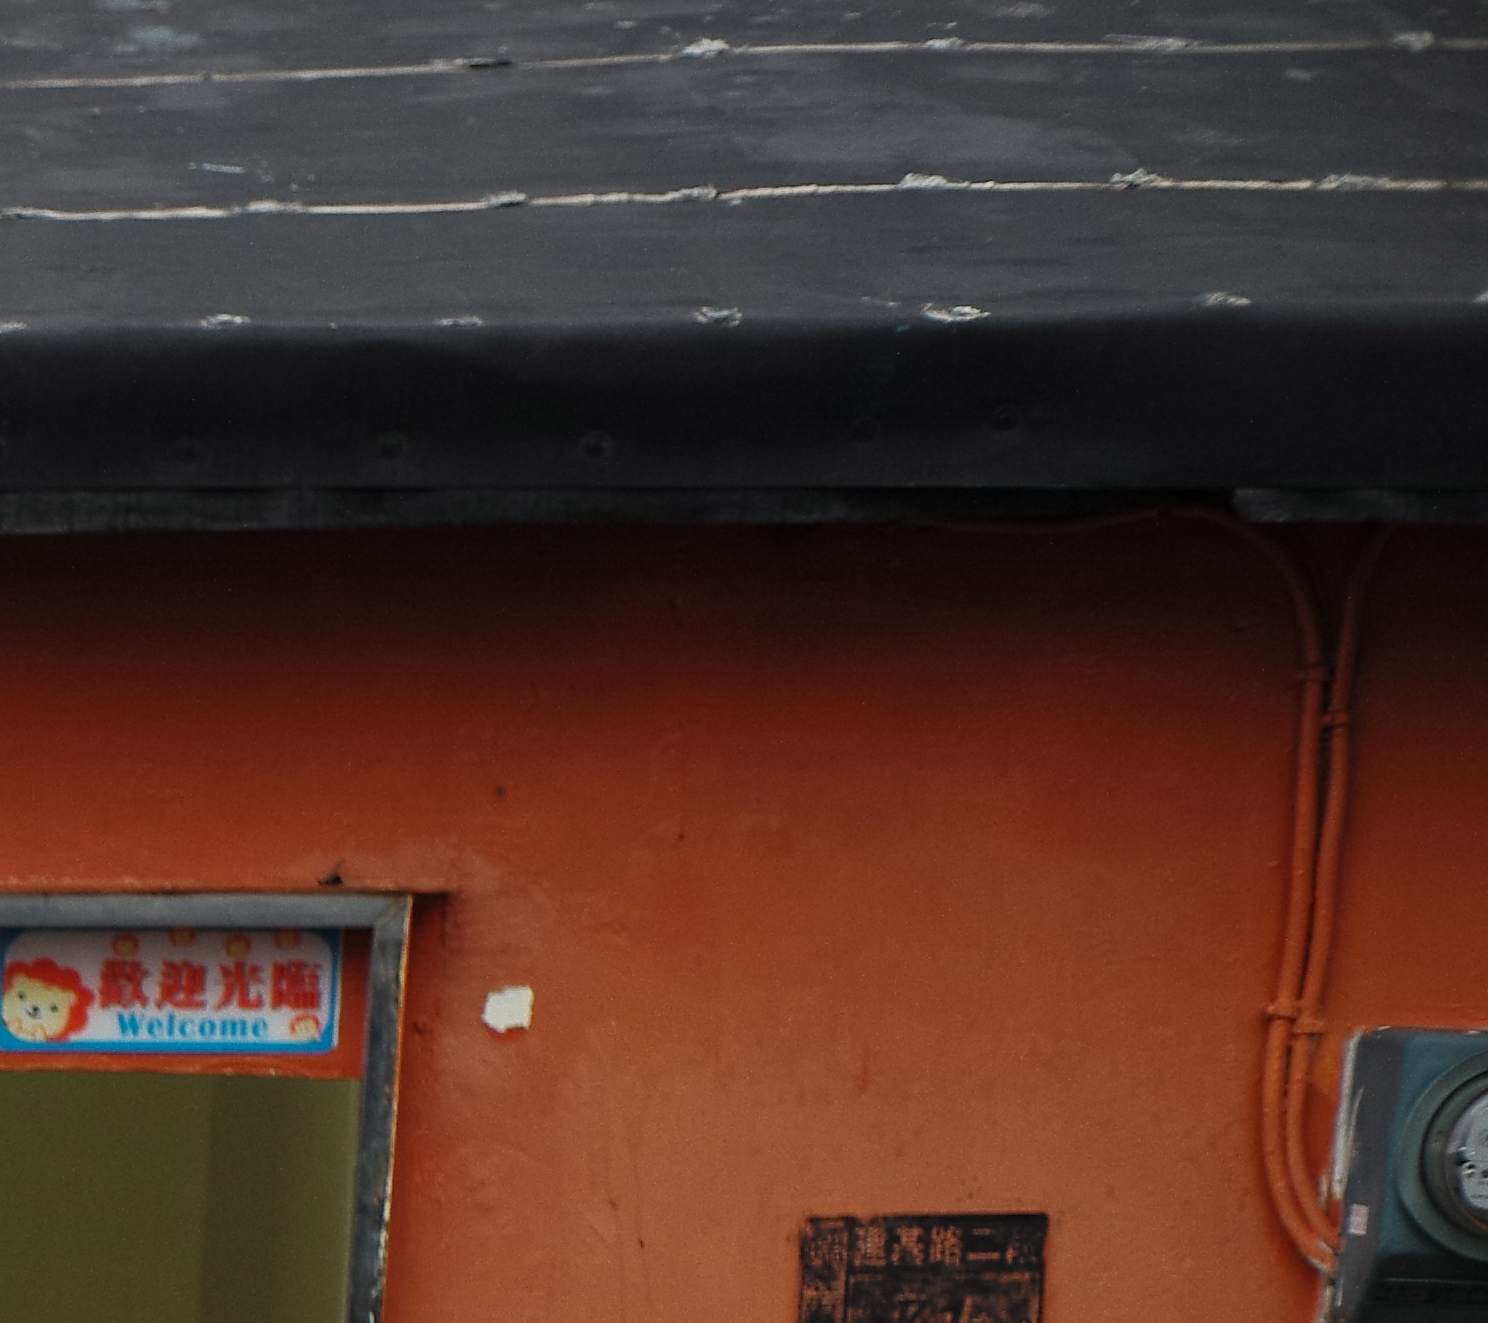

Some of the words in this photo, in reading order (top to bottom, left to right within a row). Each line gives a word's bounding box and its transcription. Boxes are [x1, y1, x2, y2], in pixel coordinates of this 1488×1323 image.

[98, 958, 323, 1011] 歡迎光臨
[115, 1012, 269, 1038] Welcome
